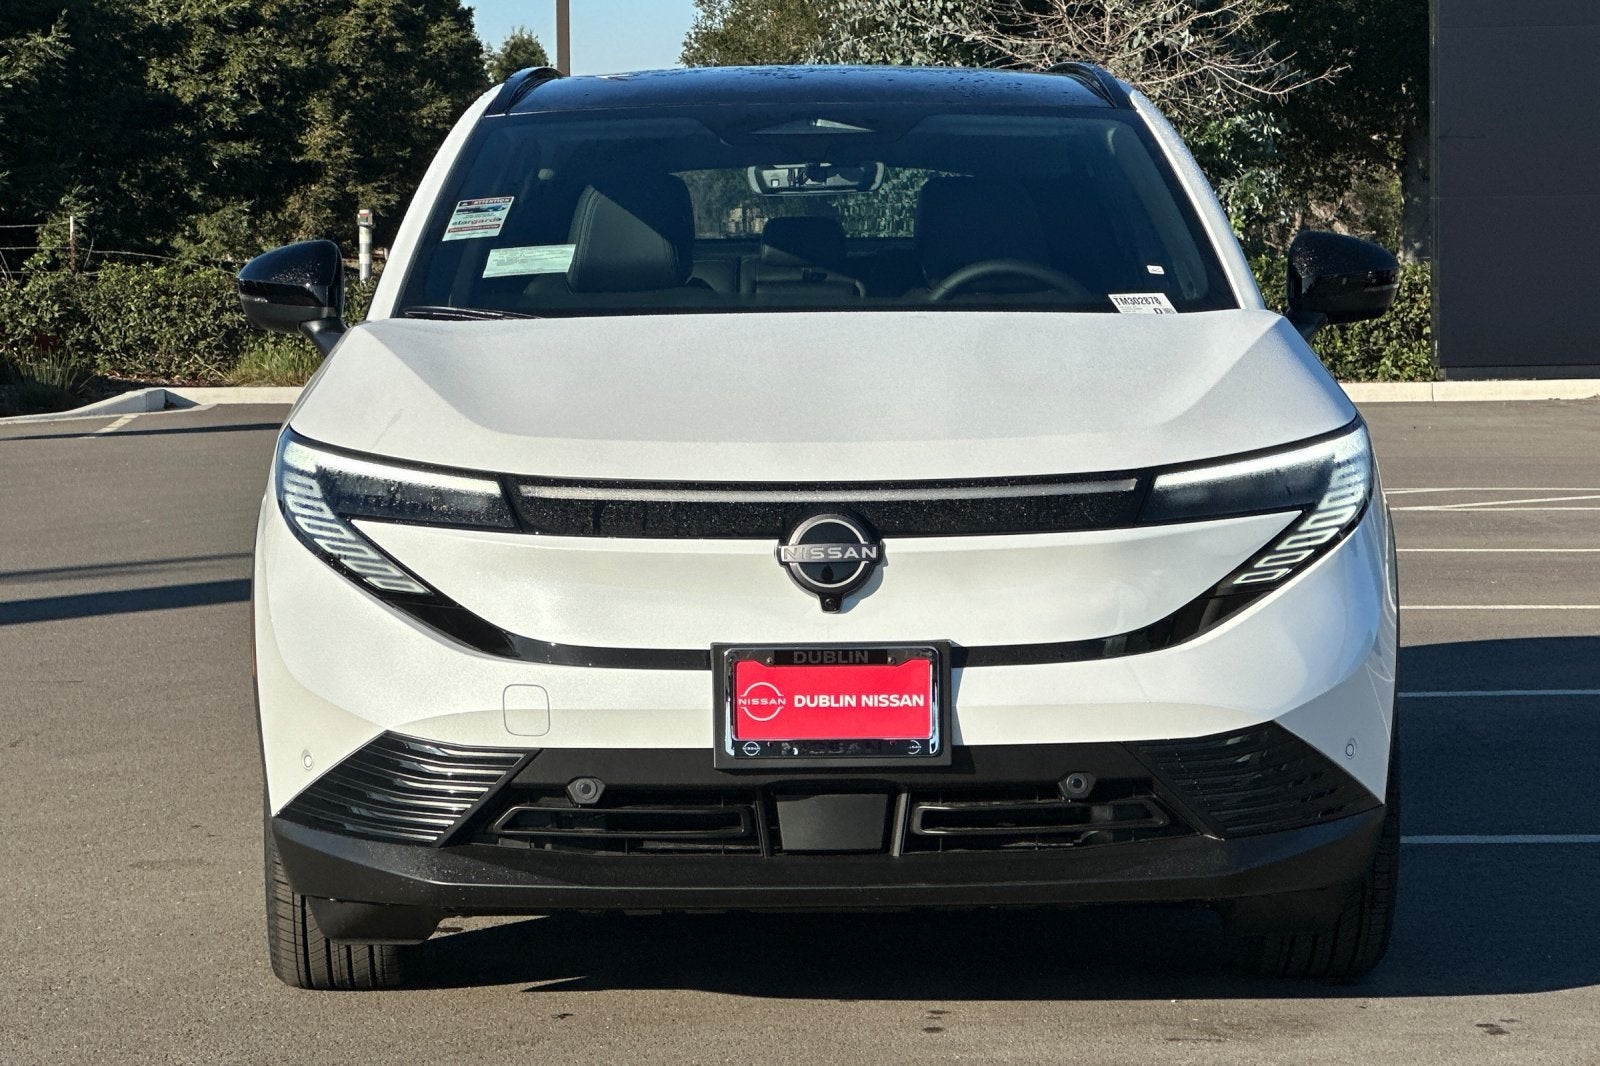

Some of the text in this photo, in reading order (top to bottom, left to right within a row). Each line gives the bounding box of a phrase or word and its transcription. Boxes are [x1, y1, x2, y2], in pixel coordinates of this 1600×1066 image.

[783, 546, 877, 560] NISSAN
[793, 650, 869, 664] DUBLIN
[738, 698, 786, 706] NISSAN
[793, 694, 925, 708] DUBLIN NISSAN
